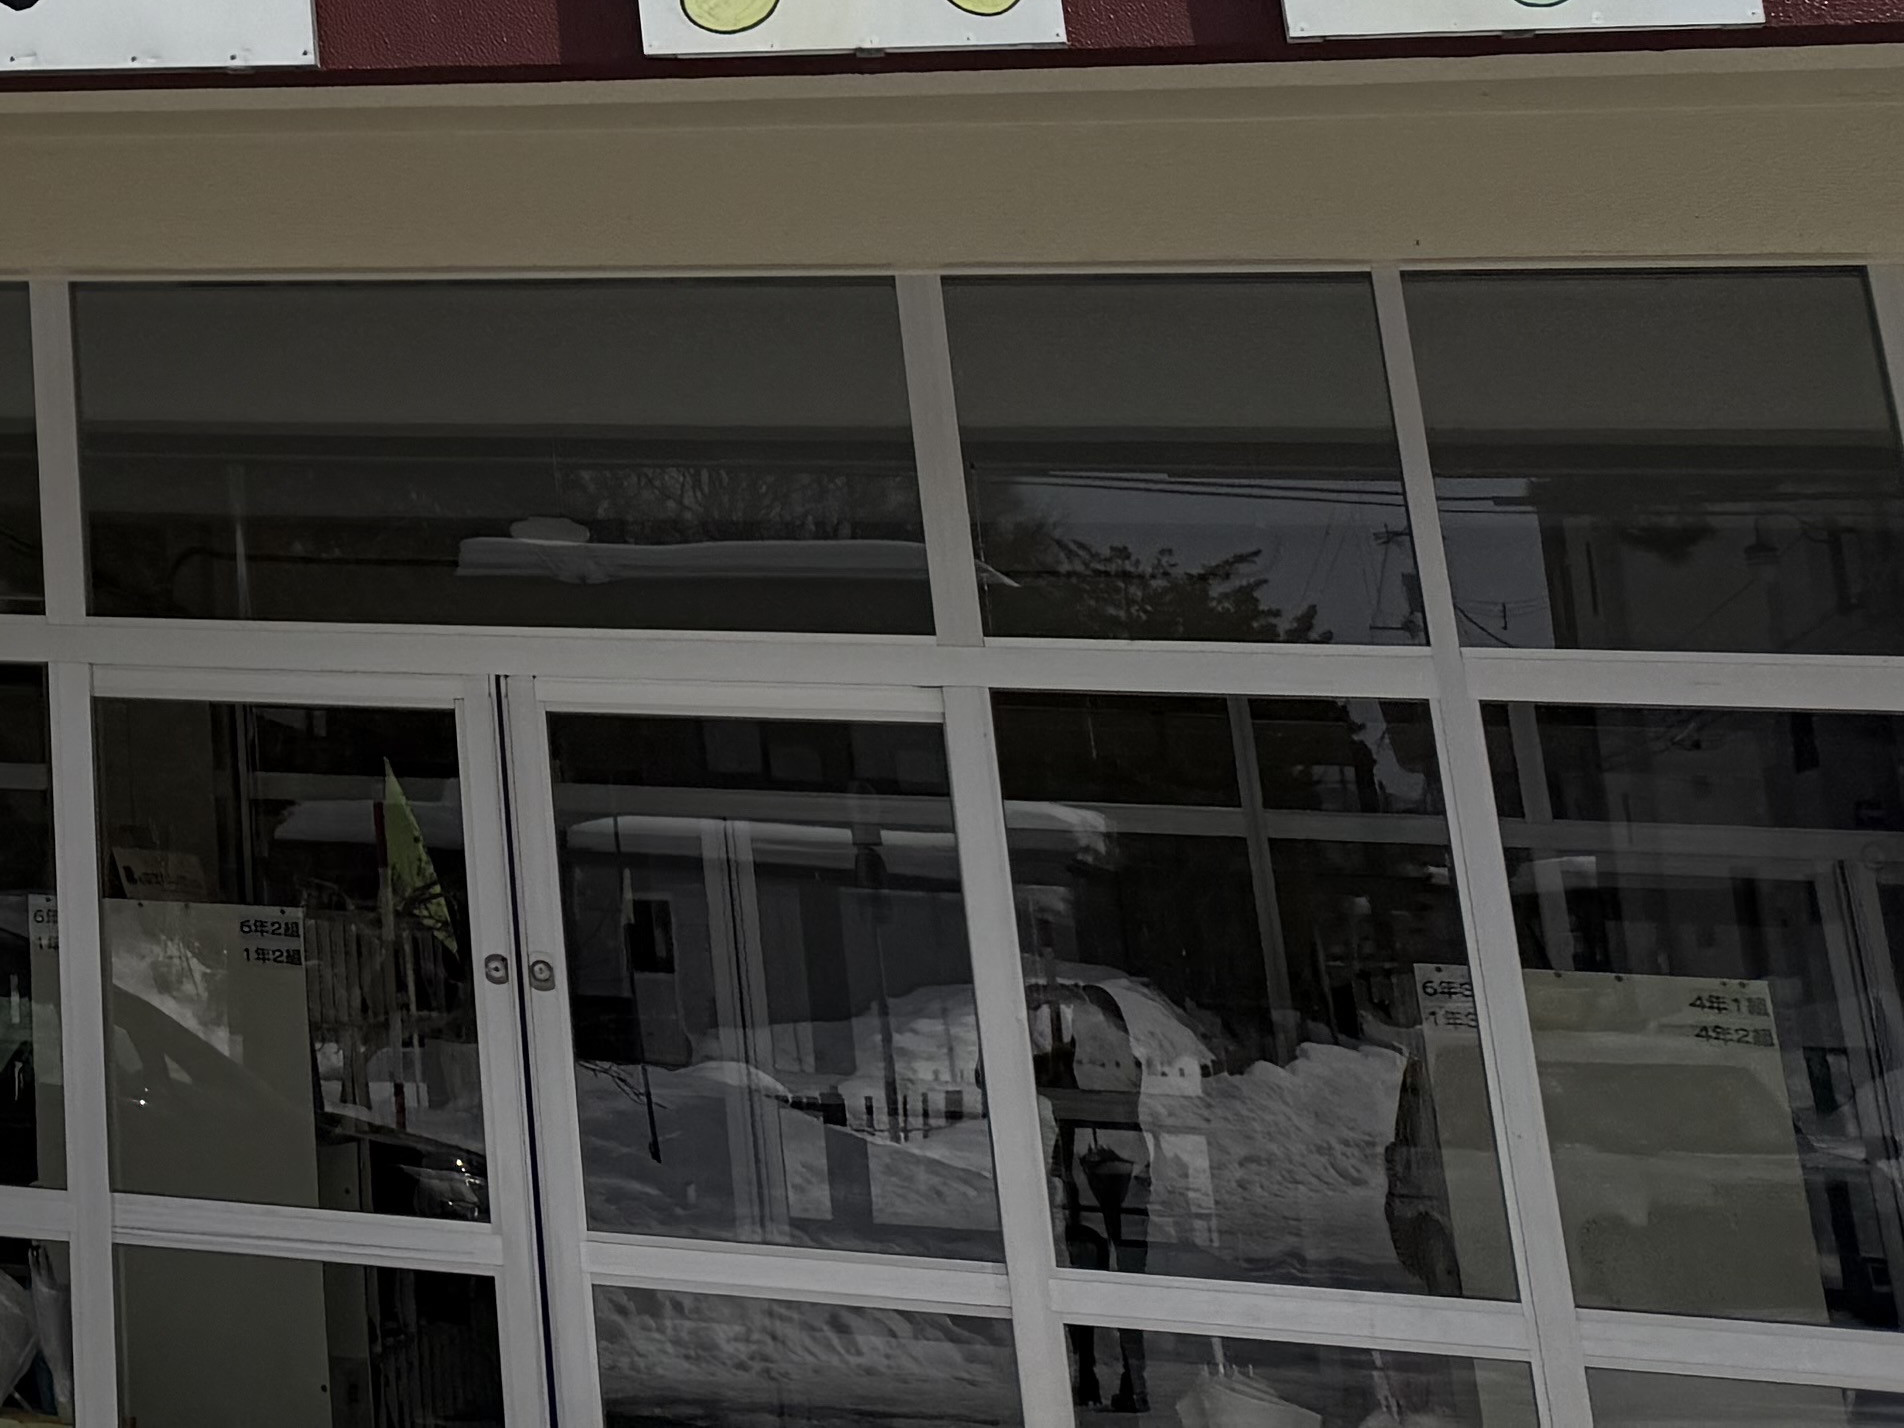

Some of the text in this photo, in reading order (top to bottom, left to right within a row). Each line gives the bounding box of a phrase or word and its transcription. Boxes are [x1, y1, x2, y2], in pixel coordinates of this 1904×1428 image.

[239, 919, 301, 938] 6年2組
[243, 946, 303, 966] 1年2組
[1688, 994, 1770, 1017] 4年1組
[1694, 1024, 1775, 1047] 4年2組
